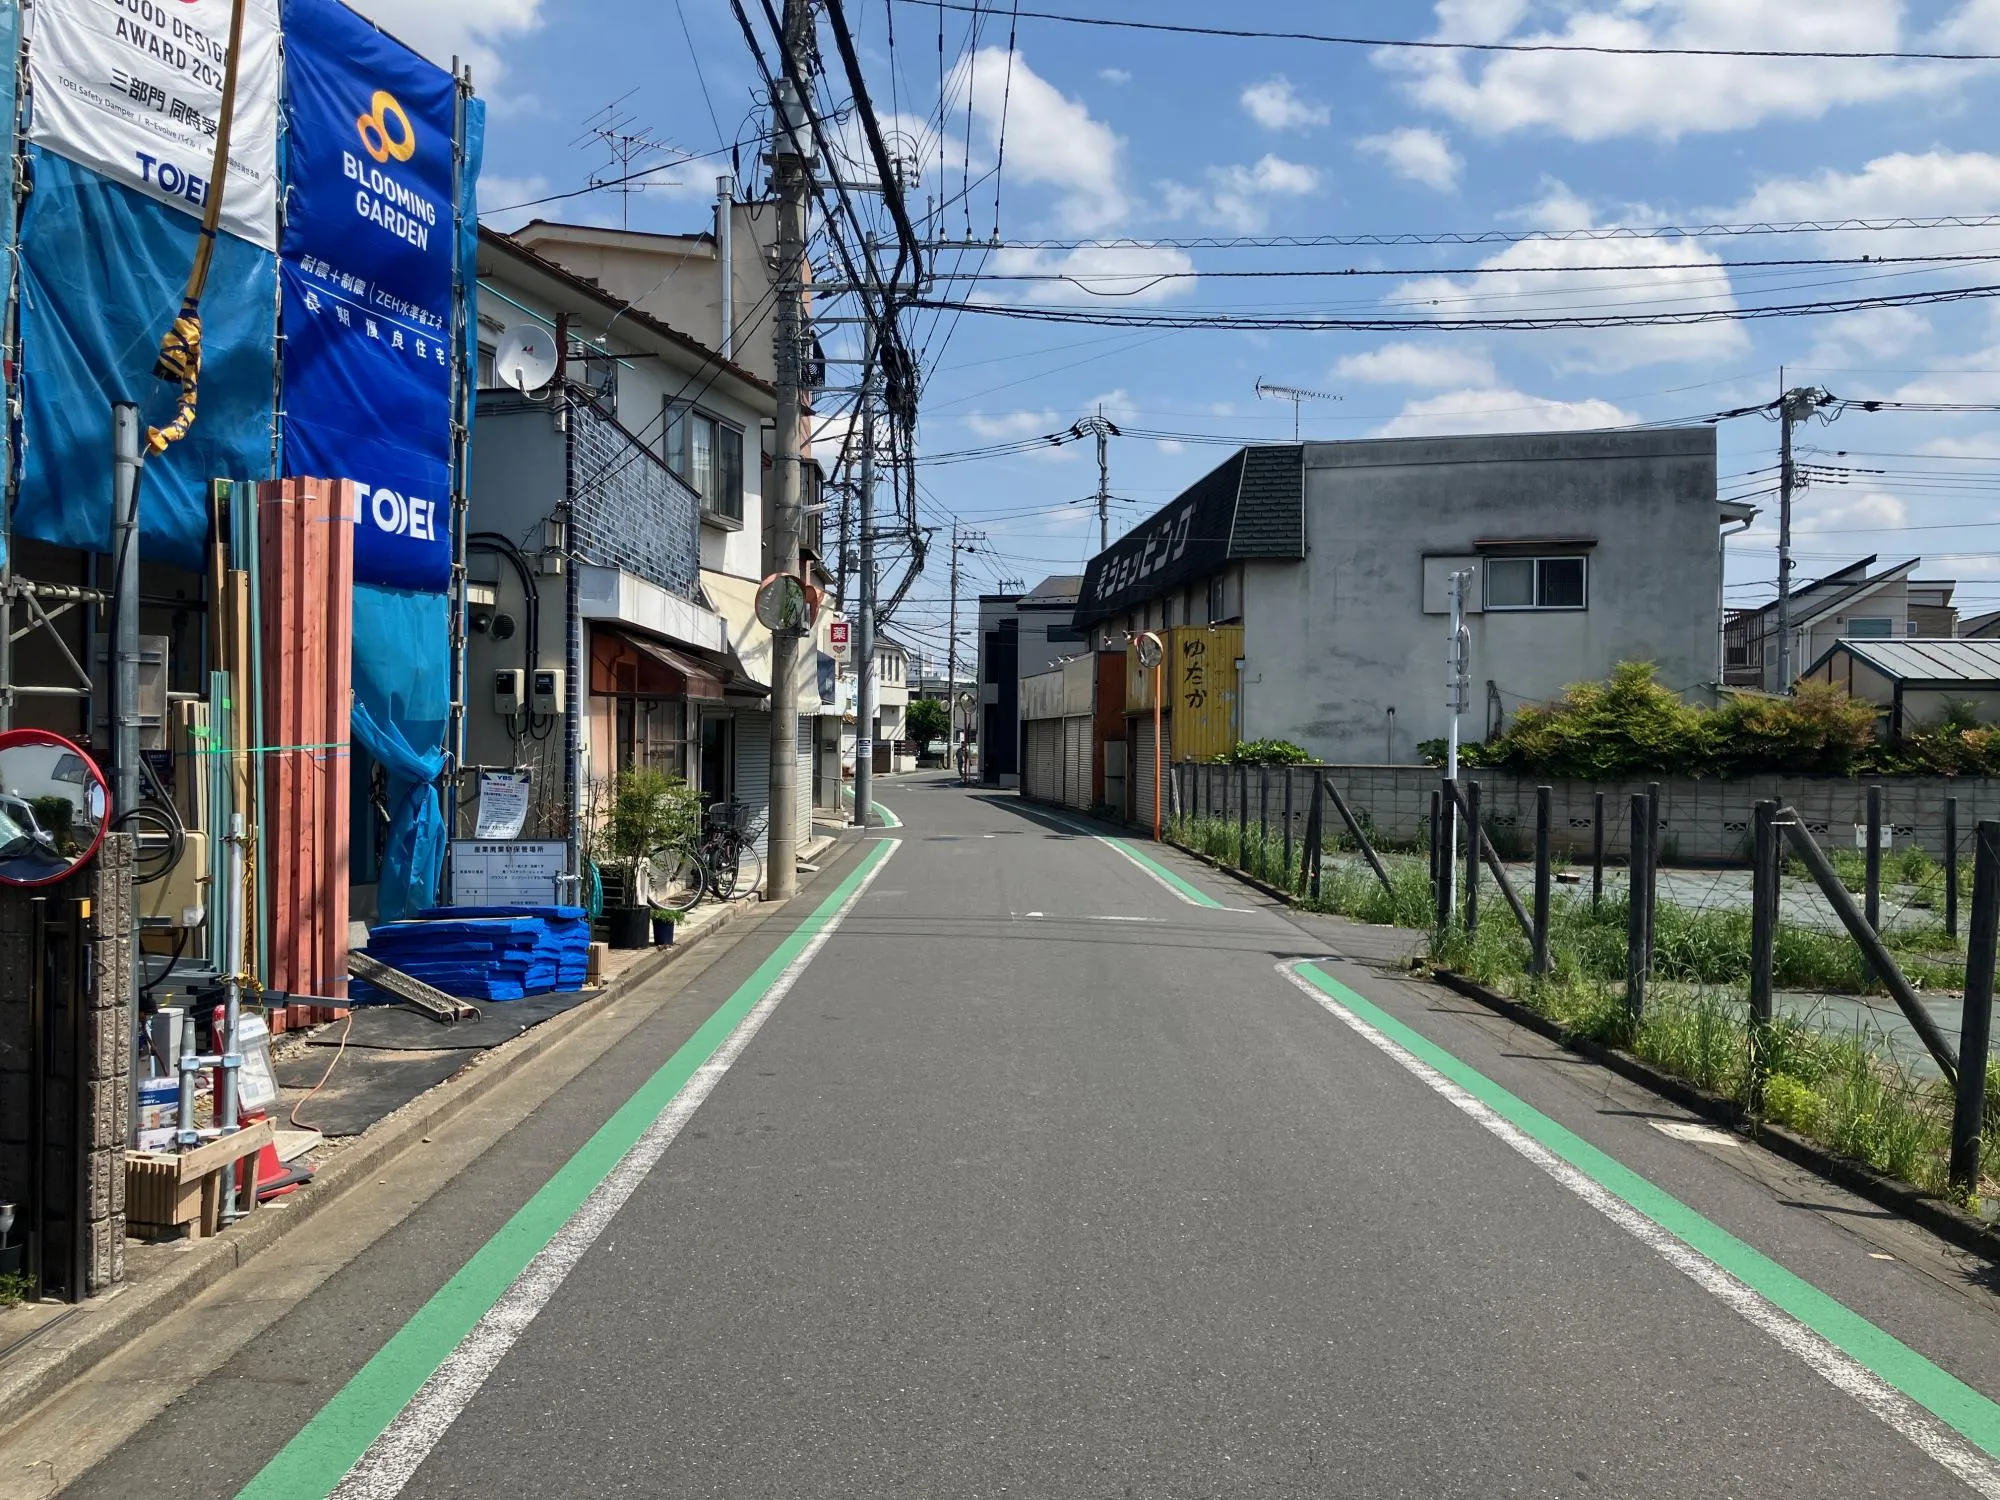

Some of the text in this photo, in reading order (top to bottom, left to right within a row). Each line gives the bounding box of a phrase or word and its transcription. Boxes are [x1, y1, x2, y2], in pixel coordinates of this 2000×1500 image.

[116, 16, 187, 70] AWARD
[58, 75, 135, 119] TOEI Safety Damper
[110, 68, 217, 140] 三部門 同時受
[343, 150, 436, 226] BLOOMING
[356, 191, 428, 251] GARDEN
[1184, 638, 1208, 709] ゆたか
